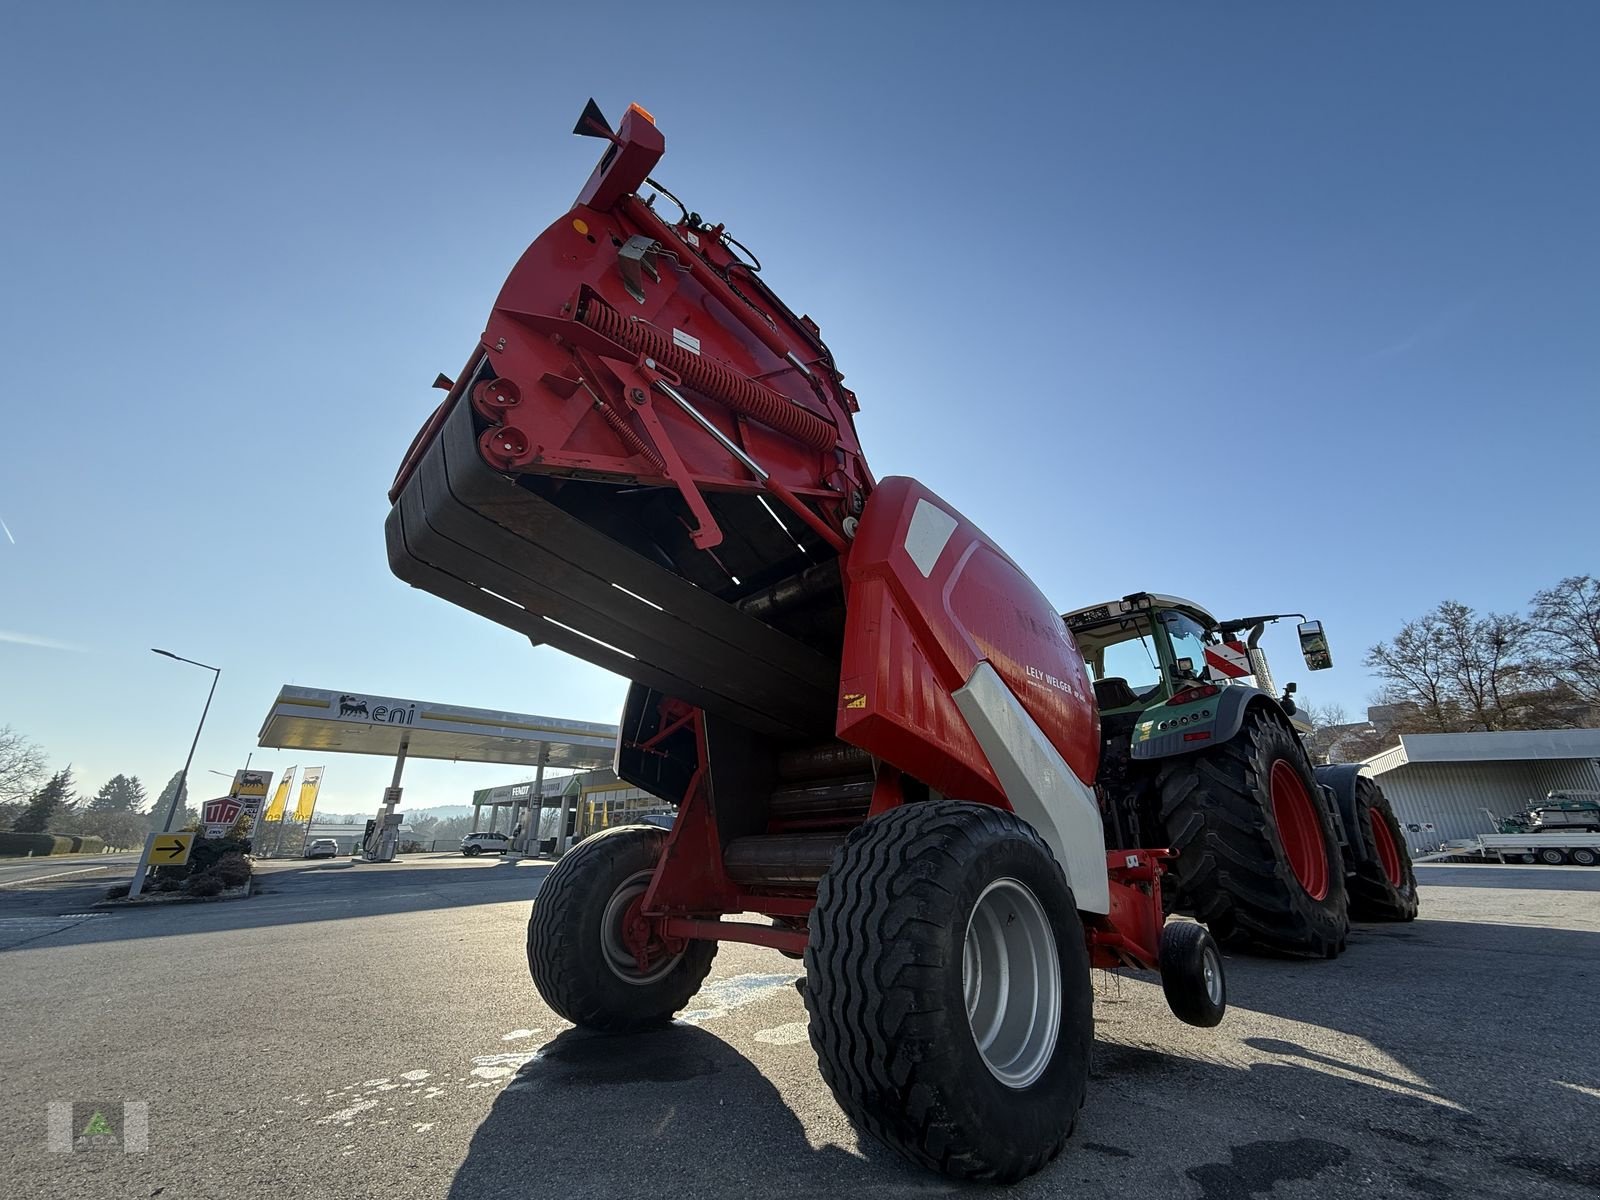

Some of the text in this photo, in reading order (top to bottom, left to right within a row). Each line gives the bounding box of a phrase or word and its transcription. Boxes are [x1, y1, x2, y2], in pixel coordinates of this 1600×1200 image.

[1026, 665, 1043, 680] LELY
[1045, 674, 1072, 695] WELGER
[372, 704, 415, 725] eni
[512, 785, 530, 796] FENDT
